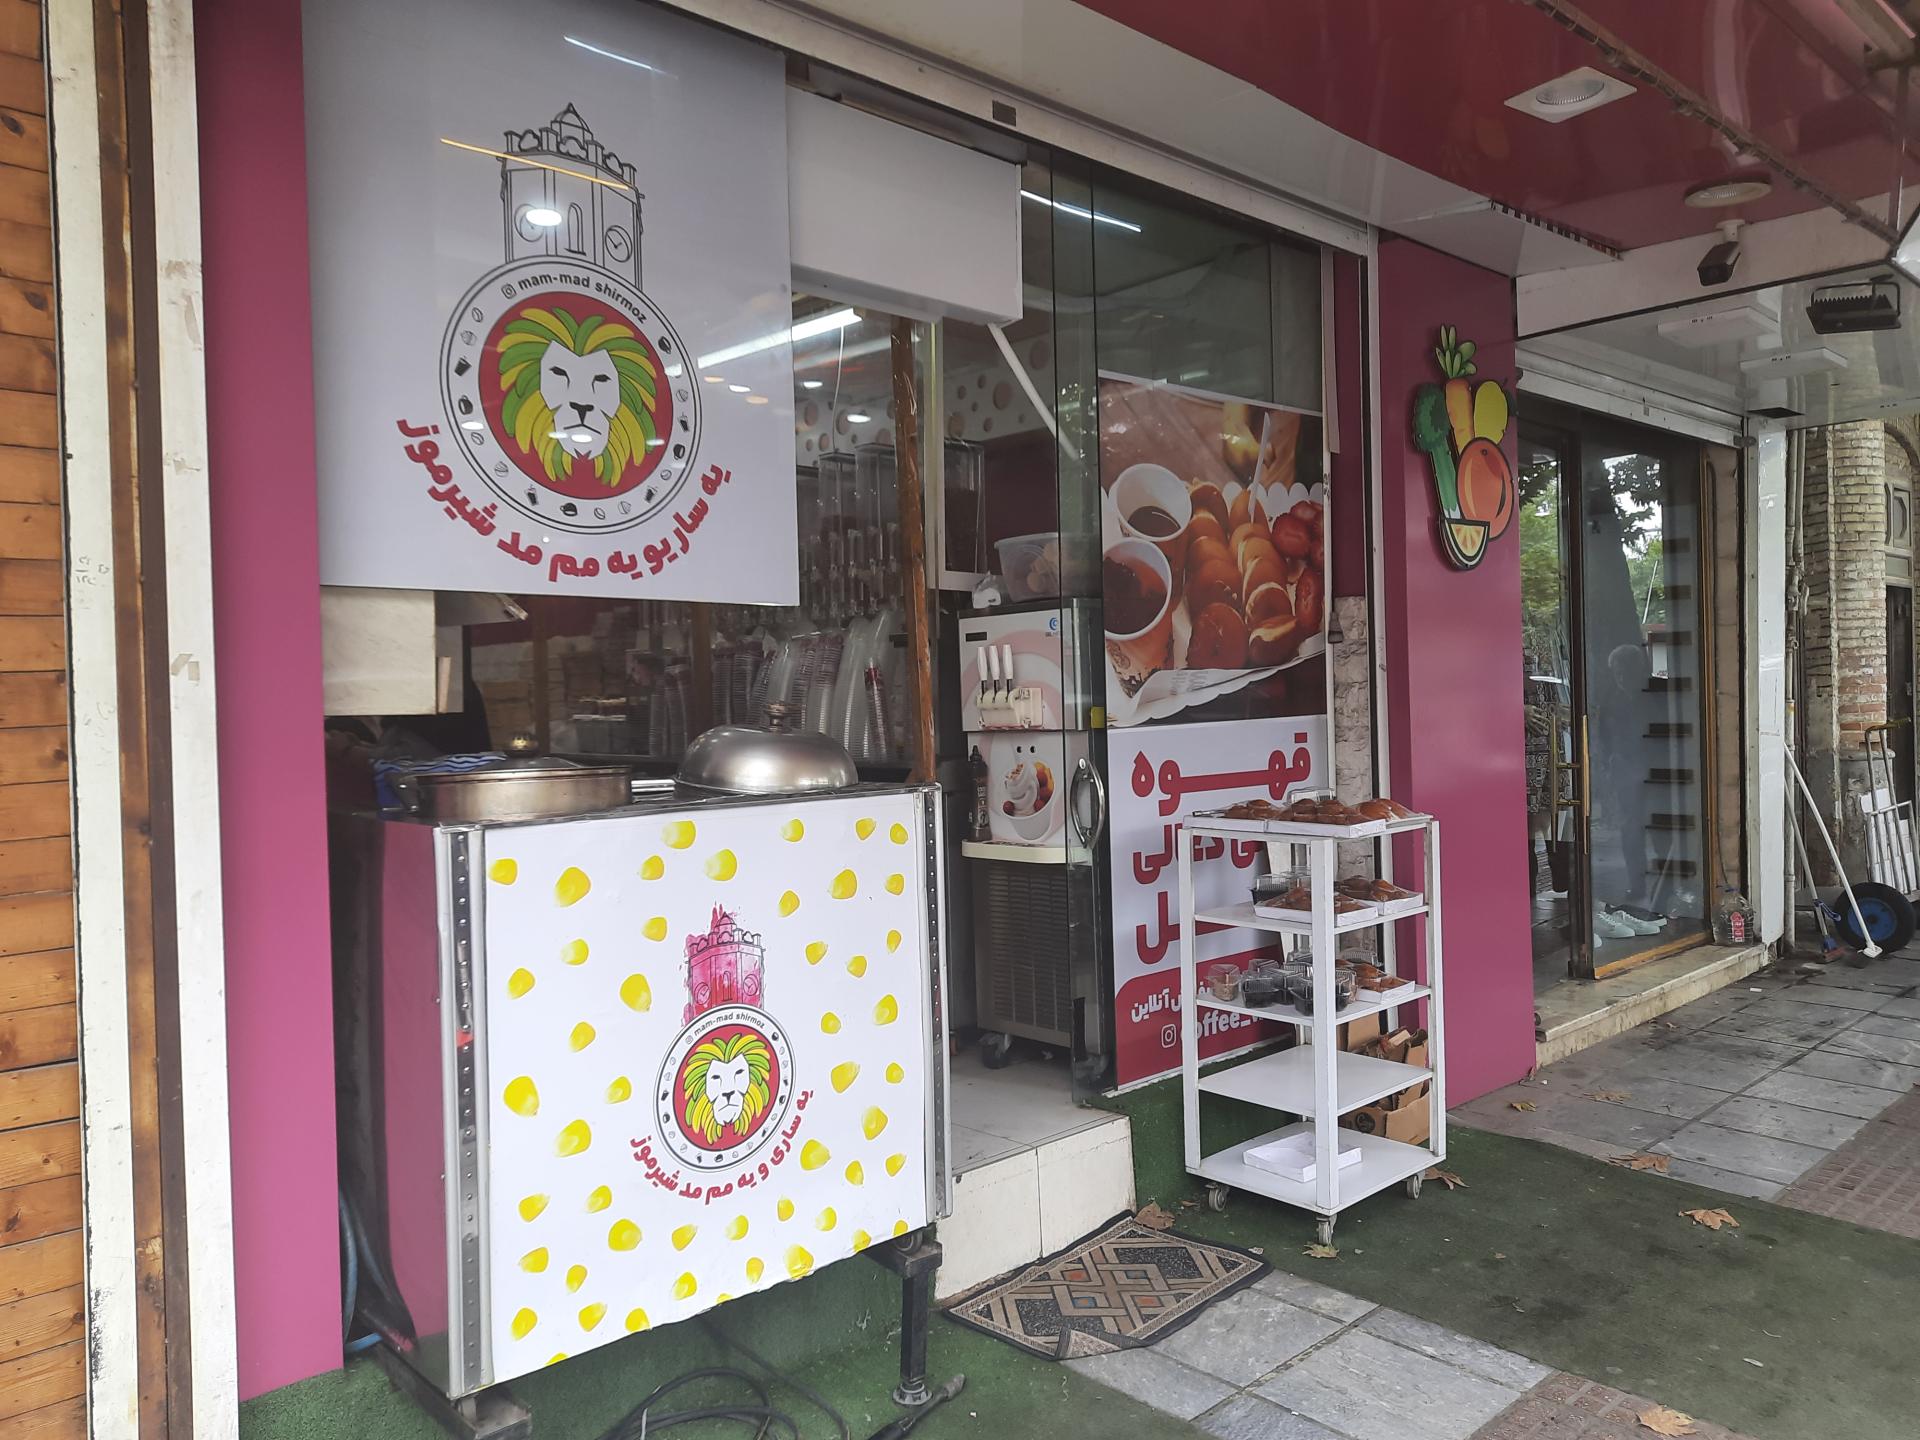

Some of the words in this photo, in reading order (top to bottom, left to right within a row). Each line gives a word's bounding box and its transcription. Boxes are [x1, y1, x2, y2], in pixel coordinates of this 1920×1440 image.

[518, 273, 590, 290] mam-mad
[595, 281, 648, 324] shirmoz
[397, 418, 498, 537] شیرموز
[1131, 732, 1312, 816] قهوه
[694, 1012, 734, 1036] mam-mad
[736, 1012, 765, 1029] shirmoz
[1131, 988, 1170, 1023] آنلاین
[630, 1135, 680, 1192] شیرموز
